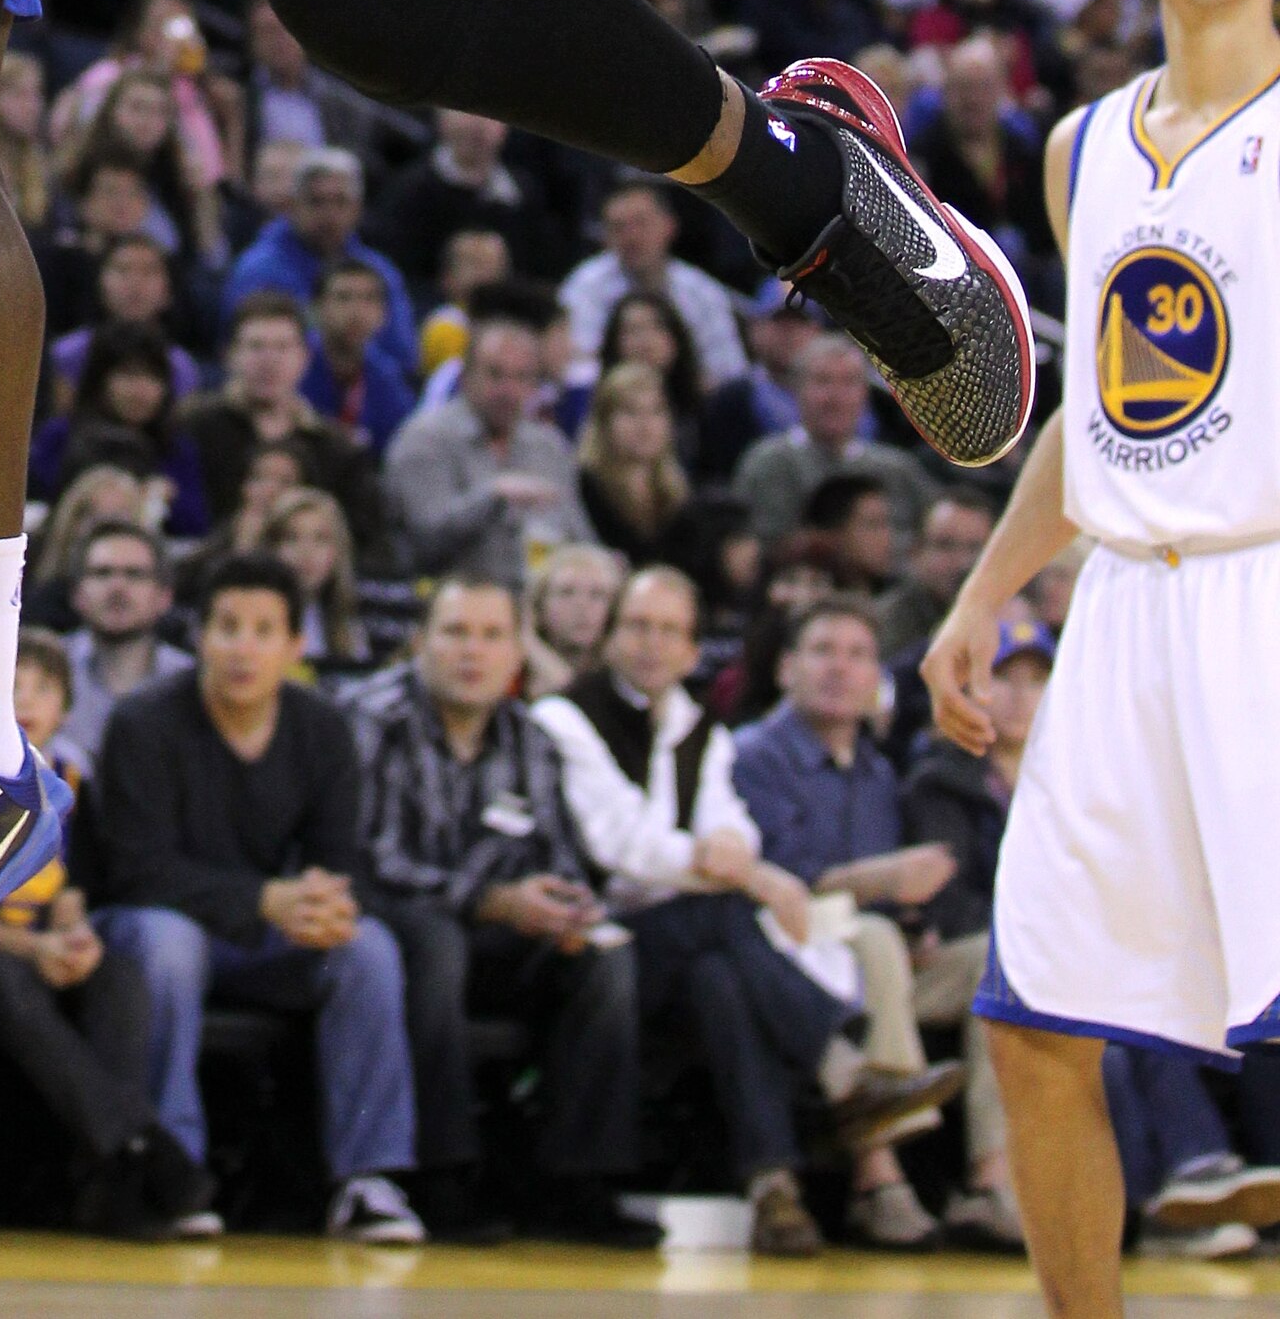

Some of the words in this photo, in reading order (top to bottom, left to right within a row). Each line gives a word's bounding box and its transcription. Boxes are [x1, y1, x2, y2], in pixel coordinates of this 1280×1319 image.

[1176, 229, 1238, 289] STATE
[1146, 283, 1204, 335] 30
[1087, 405, 1232, 473] WARRIORS
